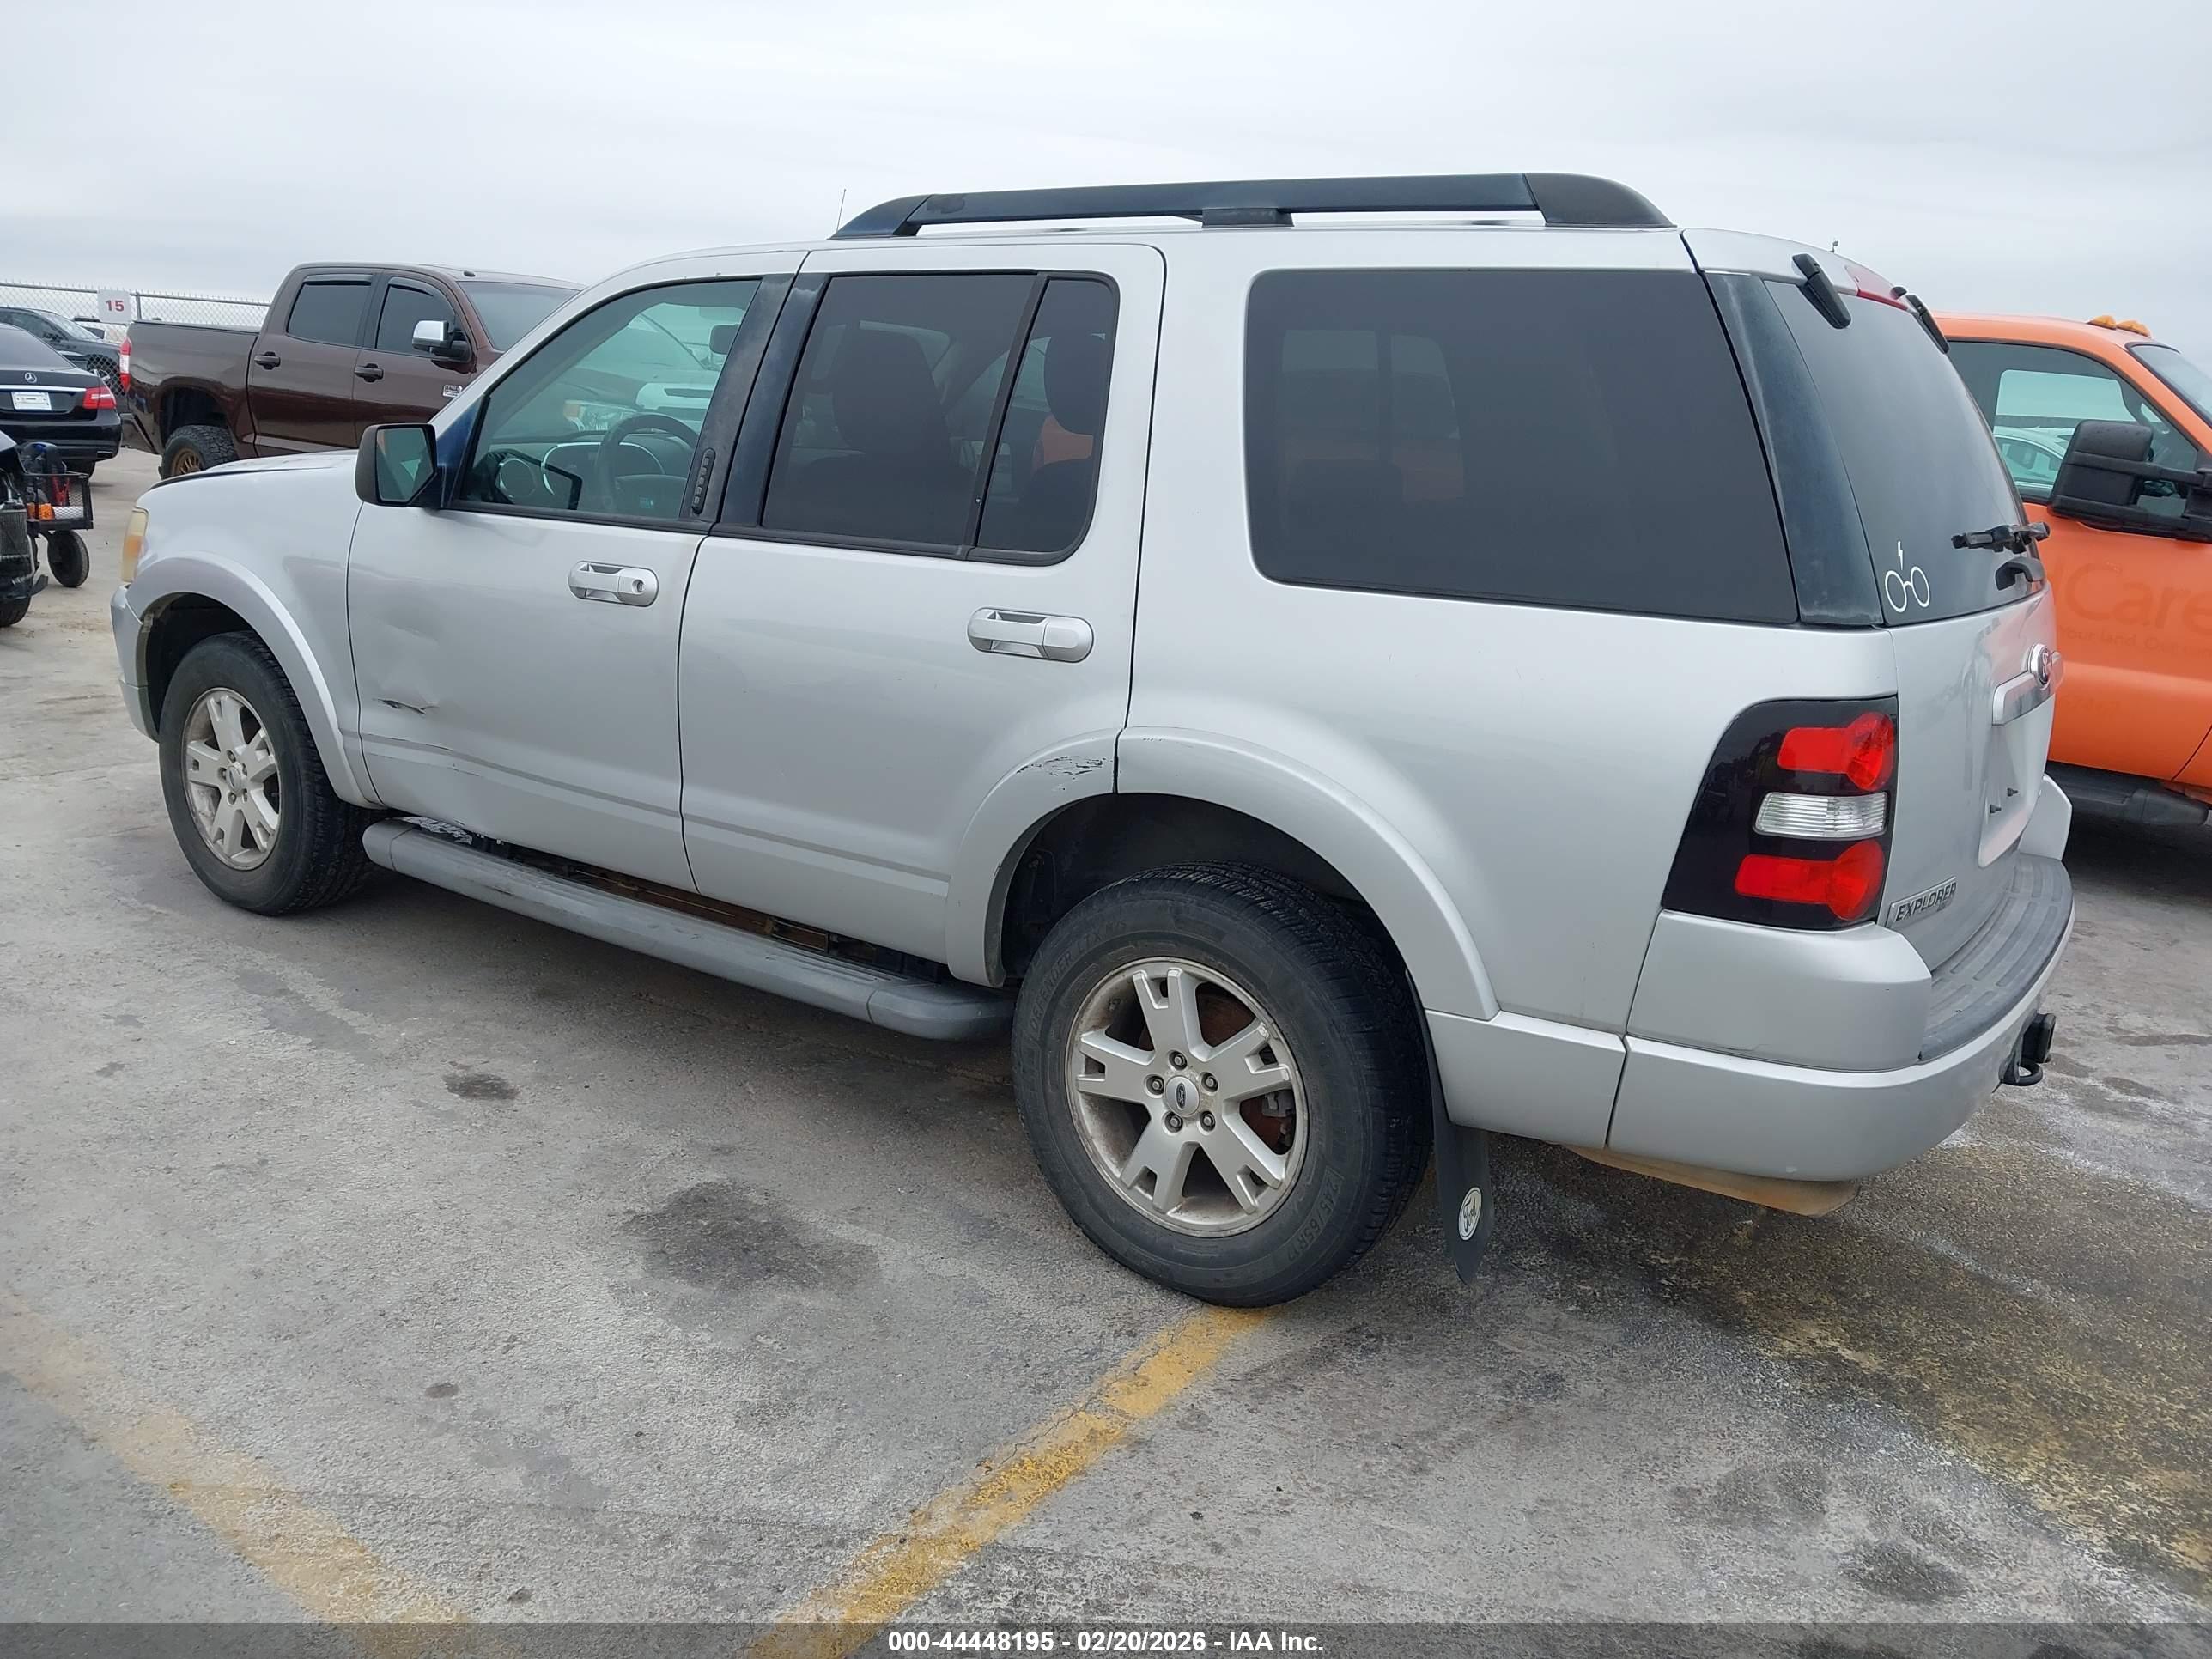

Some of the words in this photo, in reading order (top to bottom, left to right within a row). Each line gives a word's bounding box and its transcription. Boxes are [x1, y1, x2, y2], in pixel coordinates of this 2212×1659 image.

[105, 299, 125, 312] 15
[1895, 881, 1957, 921] EXPLORER
[1463, 1195, 1476, 1233] Ford
